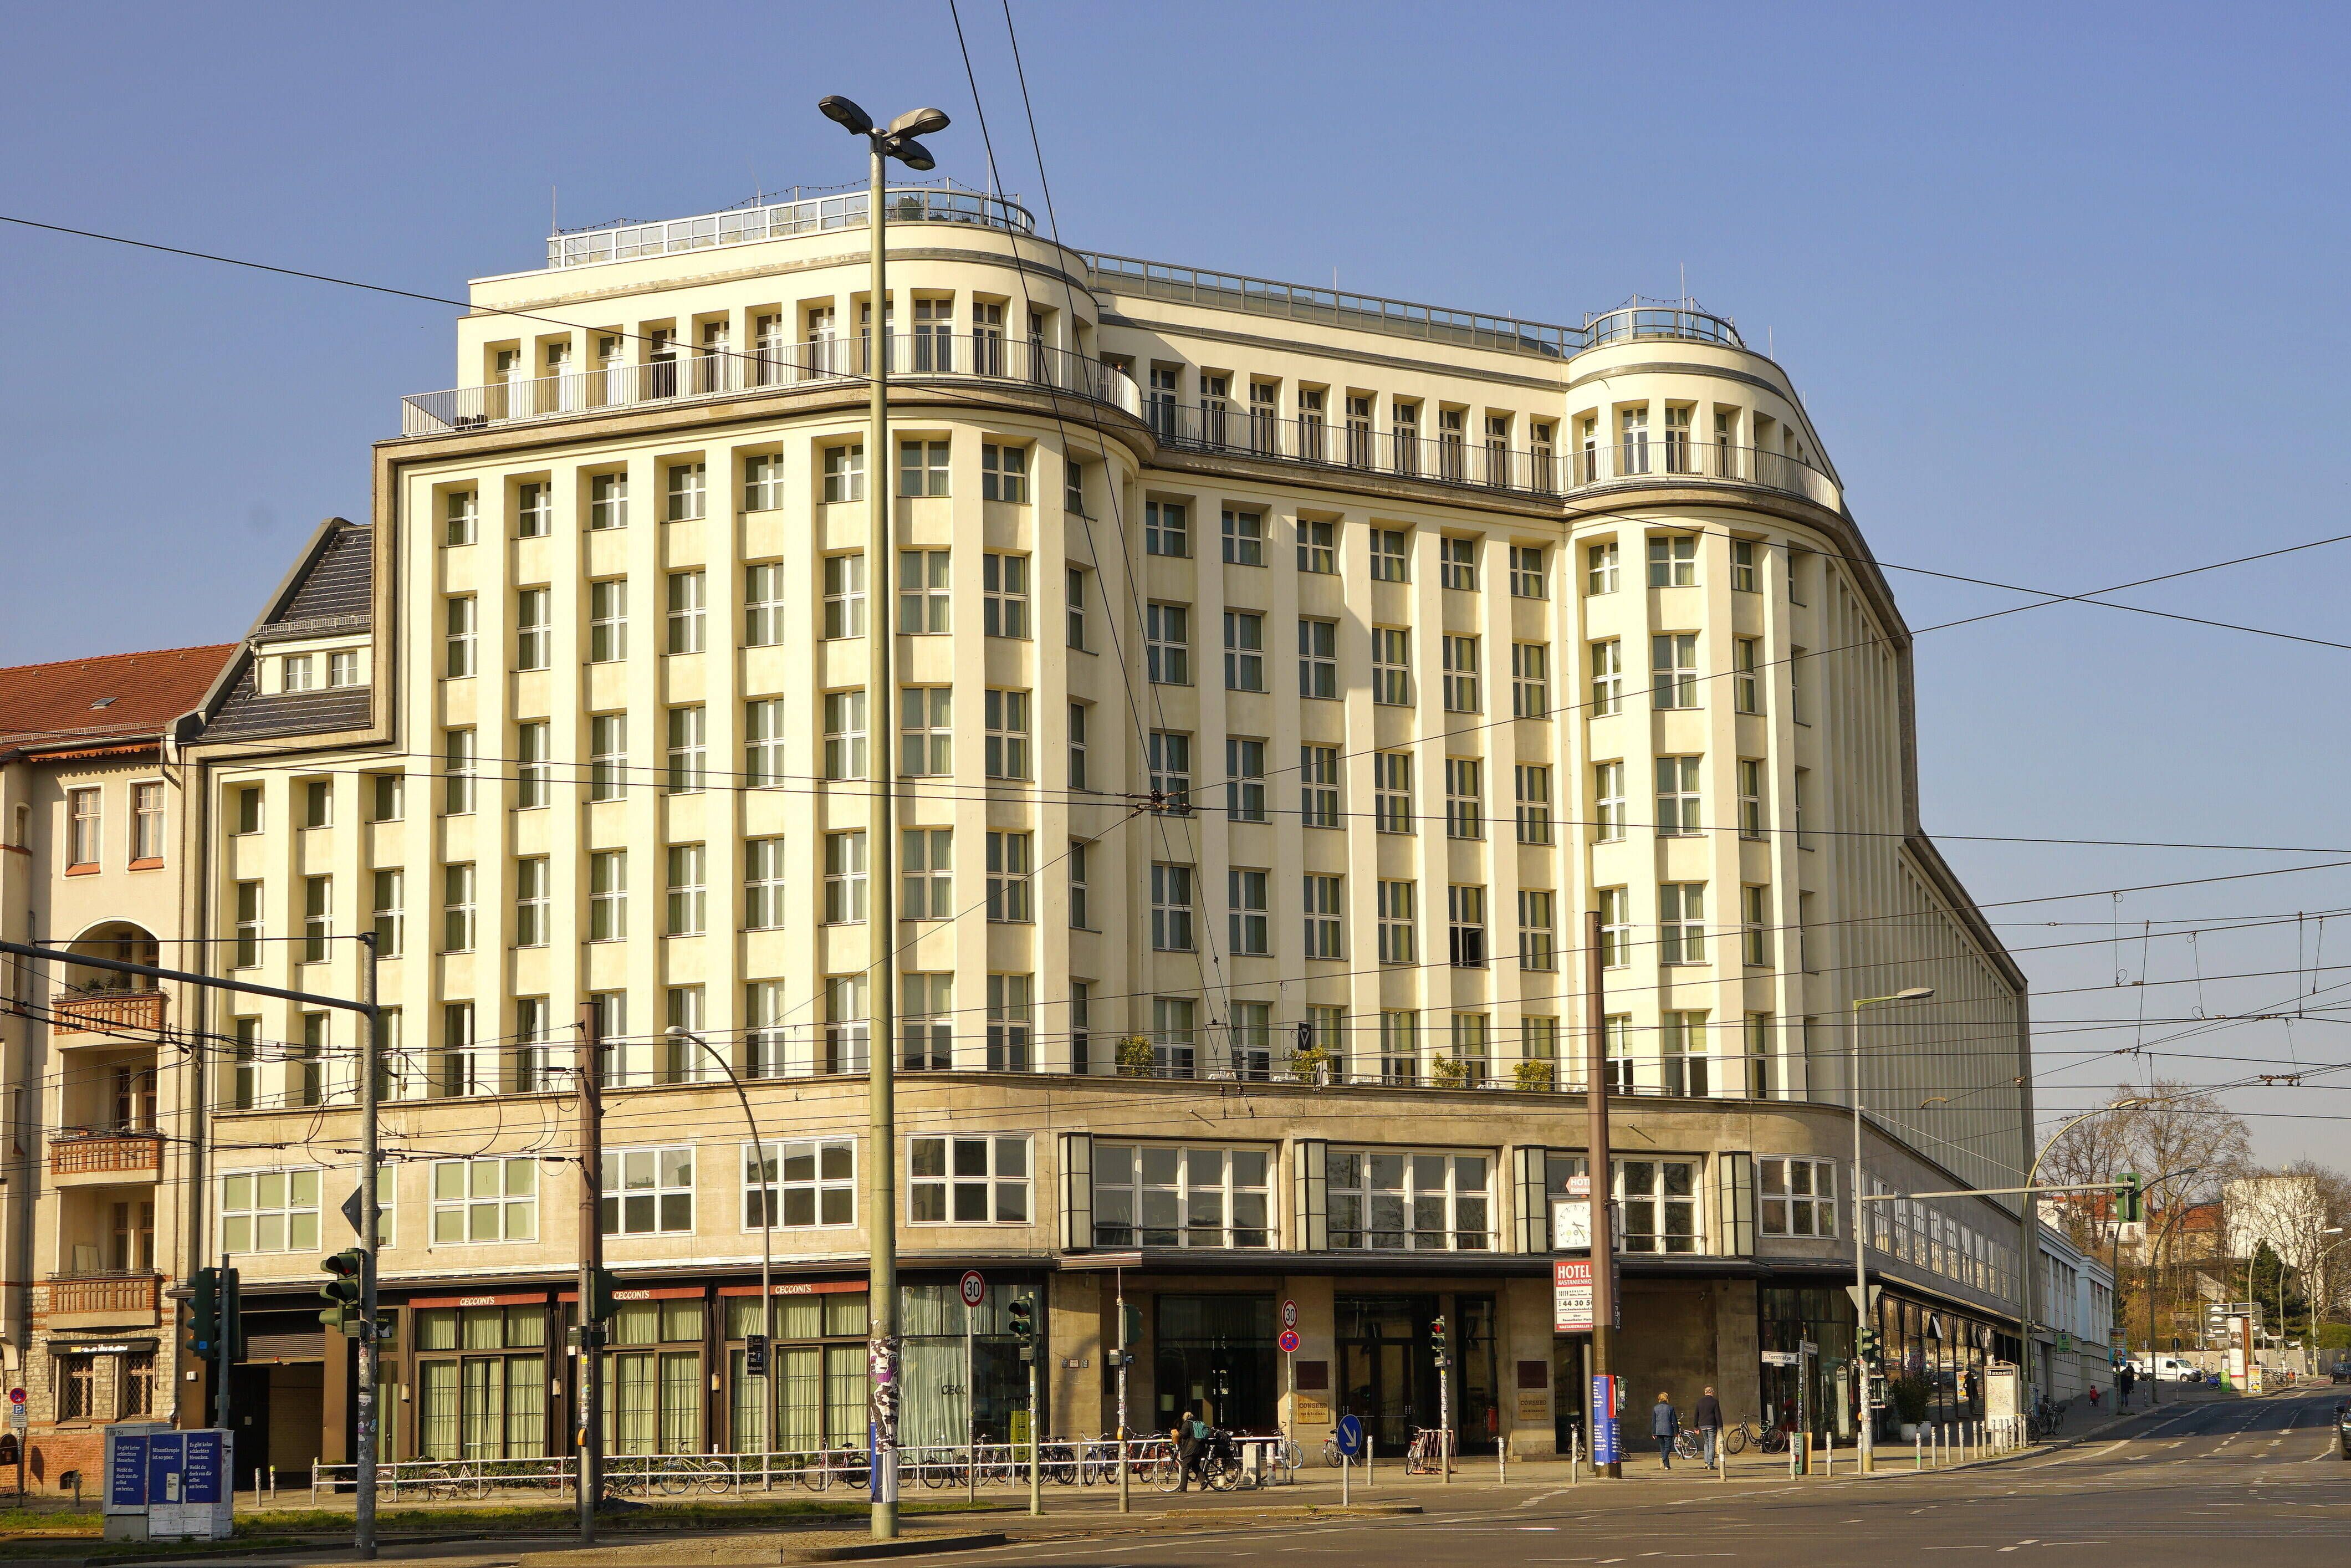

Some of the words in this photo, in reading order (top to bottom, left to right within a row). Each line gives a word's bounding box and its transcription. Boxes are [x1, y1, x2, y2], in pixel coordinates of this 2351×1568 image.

[1558, 1265, 1591, 1279] HOTEL
[775, 1284, 812, 1294] CECCONI'S
[966, 1281, 980, 1297] 30
[614, 1290, 650, 1300] CECCONI'S
[459, 1296, 495, 1306] CECCONI'S
[1286, 1309, 1295, 1321] 30
